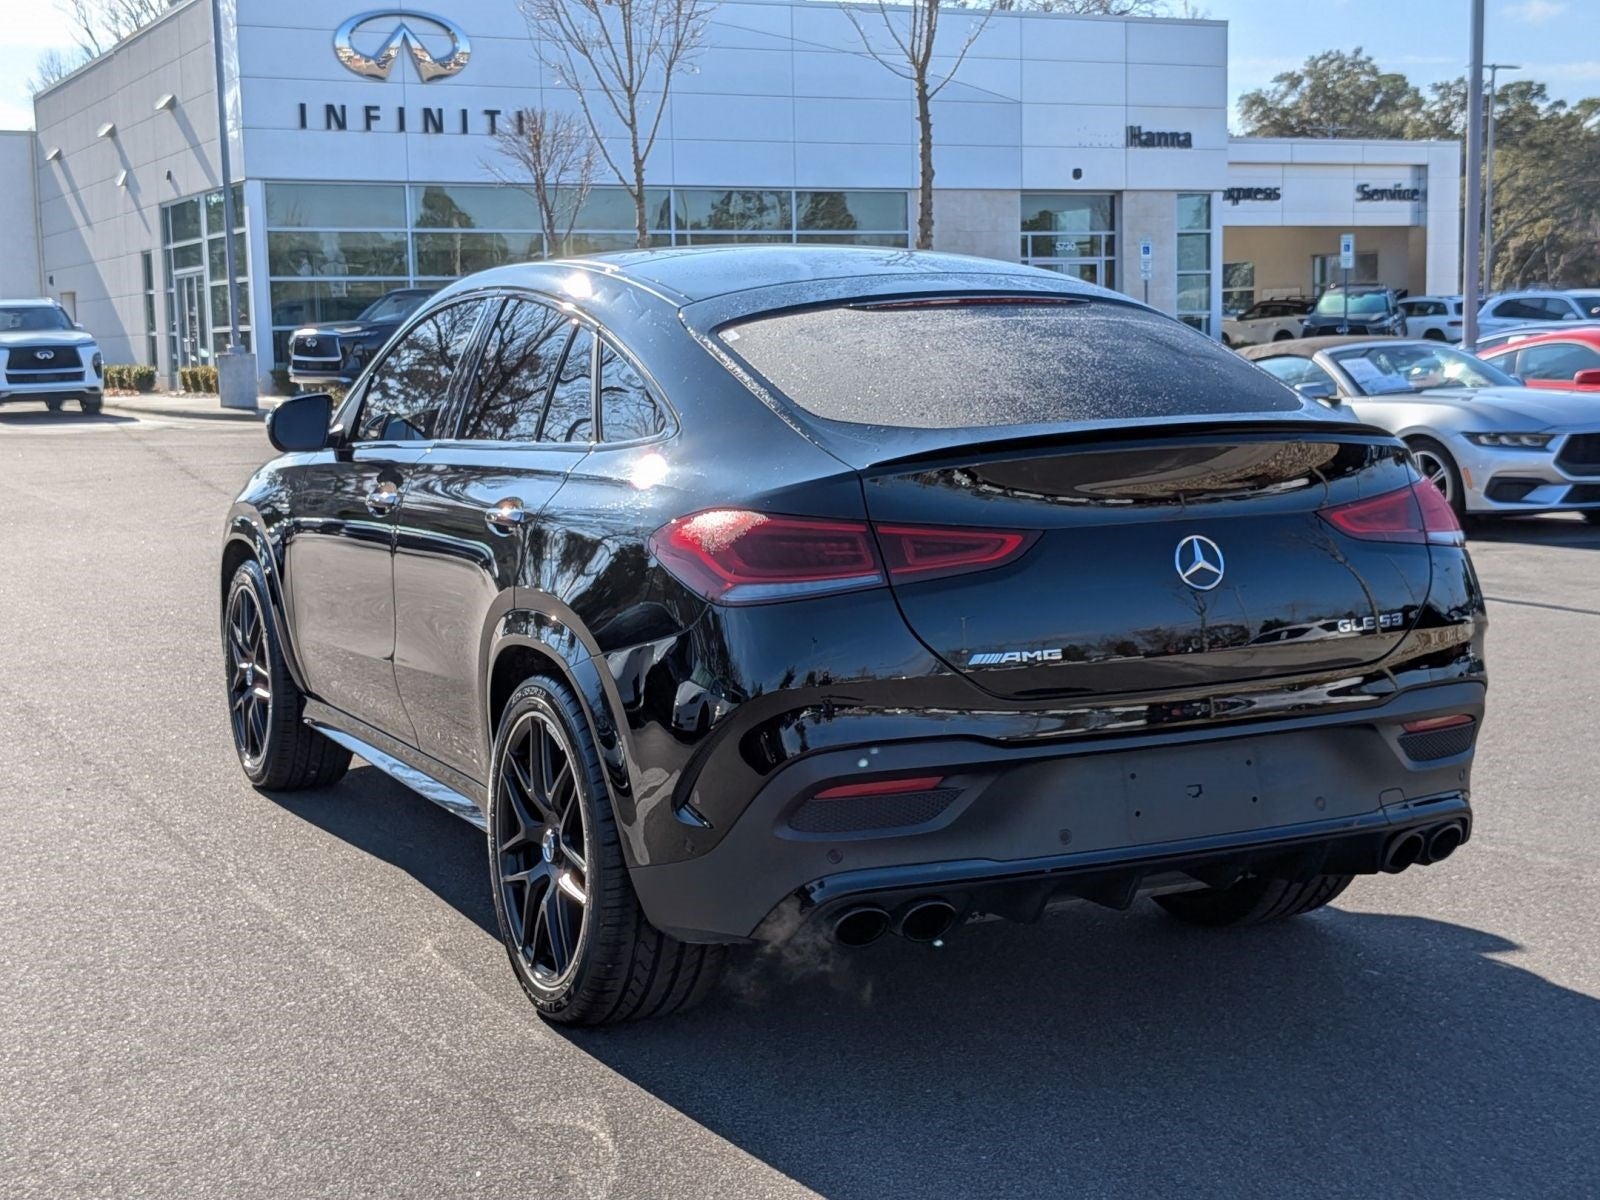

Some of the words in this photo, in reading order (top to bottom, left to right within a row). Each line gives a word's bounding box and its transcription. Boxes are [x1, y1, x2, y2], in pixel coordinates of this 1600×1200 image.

[298, 103, 525, 136] INFINITI
[1126, 125, 1193, 148] Hanna
[1222, 187, 1281, 206] xpress
[1355, 183, 1420, 202] Service
[1338, 616, 1376, 633] GLE
[1379, 612, 1404, 628] 53
[1000, 648, 1063, 664] AMG
